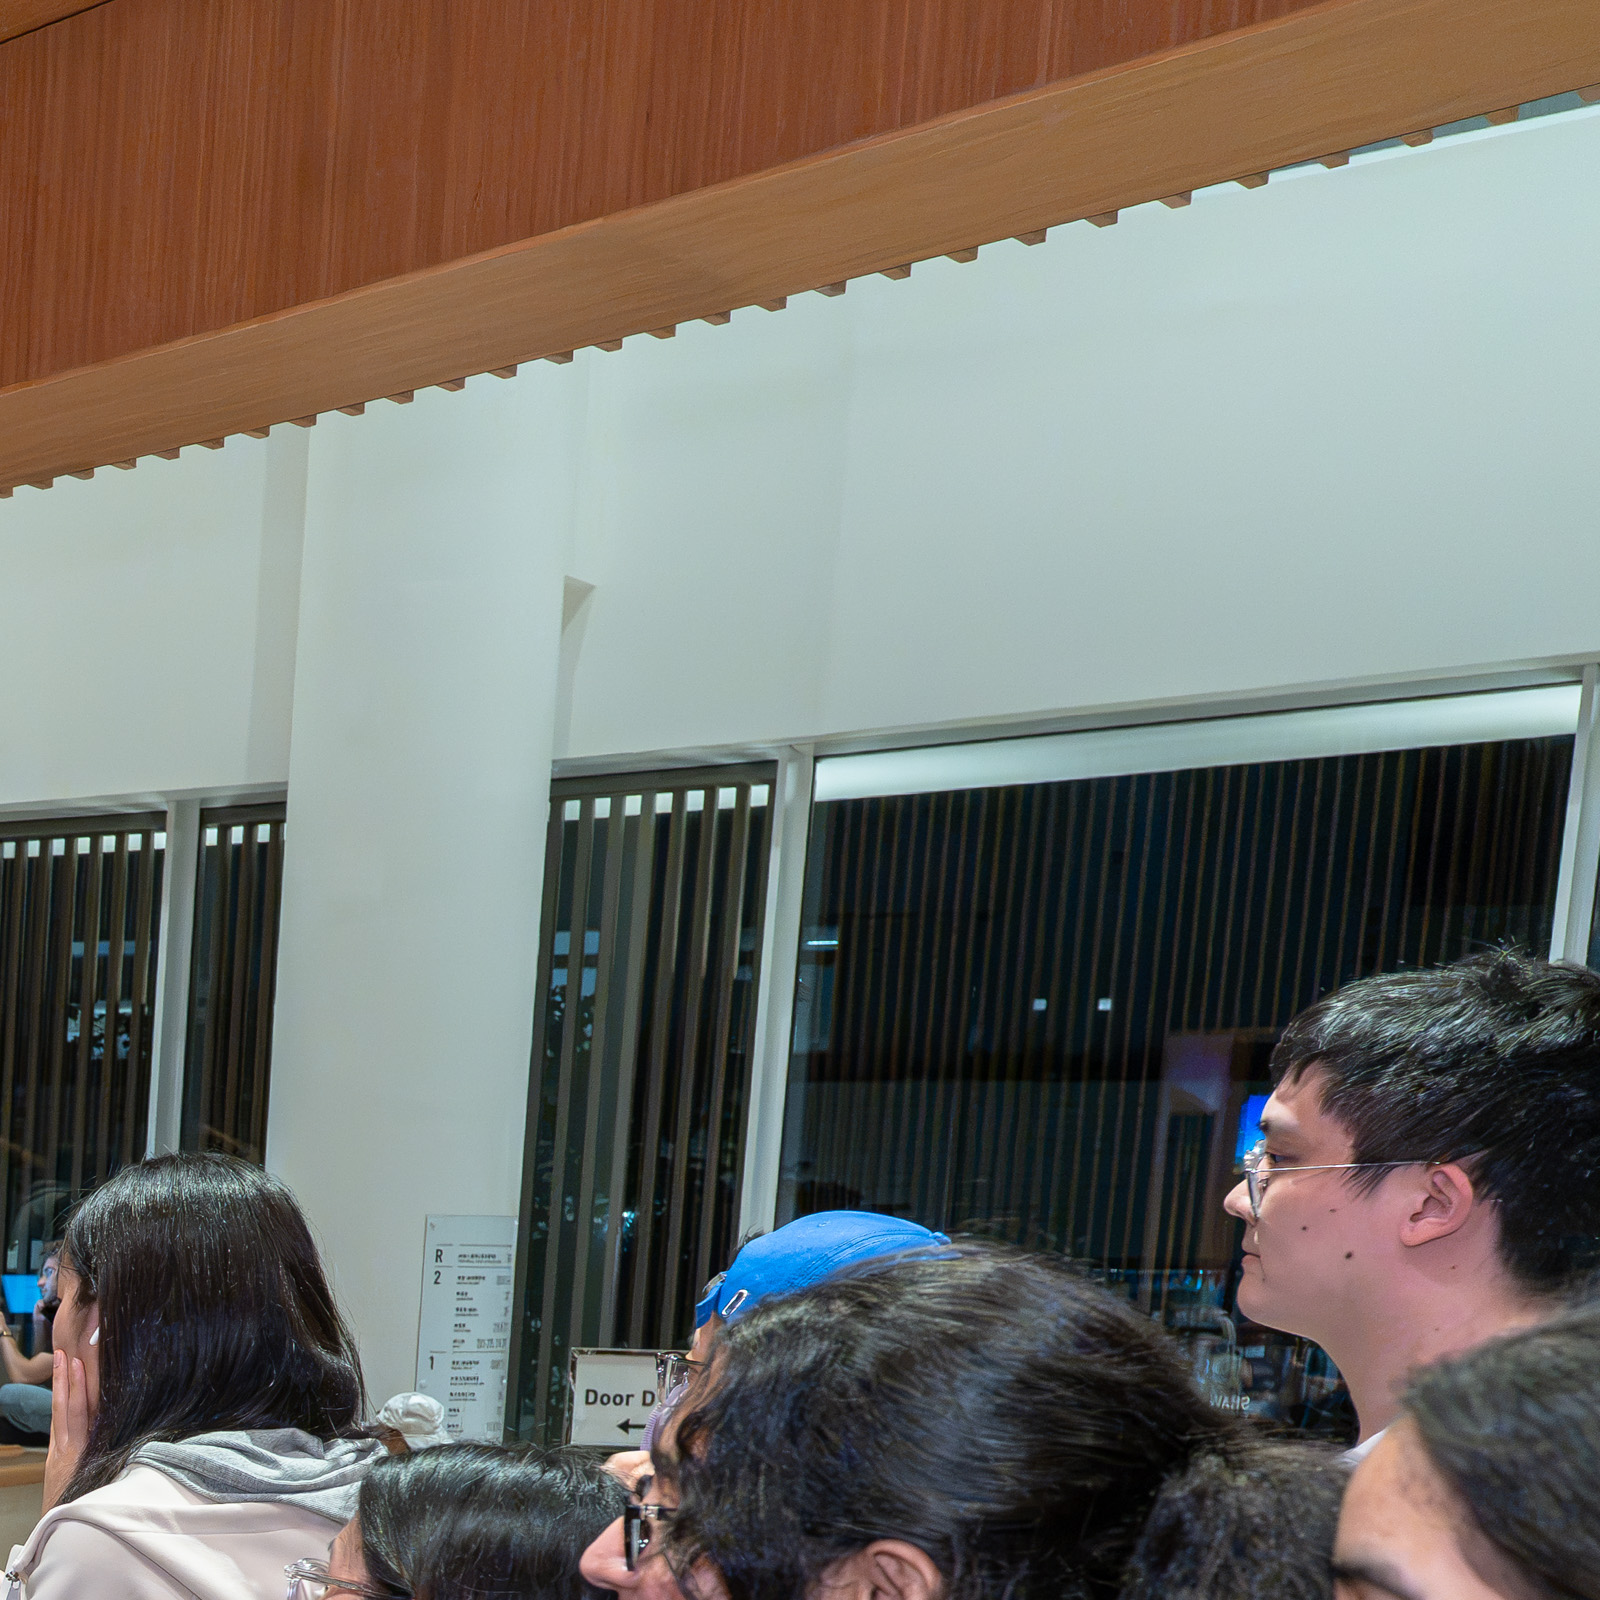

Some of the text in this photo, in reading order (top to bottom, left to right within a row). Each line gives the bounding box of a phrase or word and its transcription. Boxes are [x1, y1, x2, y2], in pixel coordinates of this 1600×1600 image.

[435, 1248, 443, 1263] R
[434, 1270, 442, 1285] 2
[429, 1355, 435, 1370] 1
[585, 1388, 656, 1407] Door D
